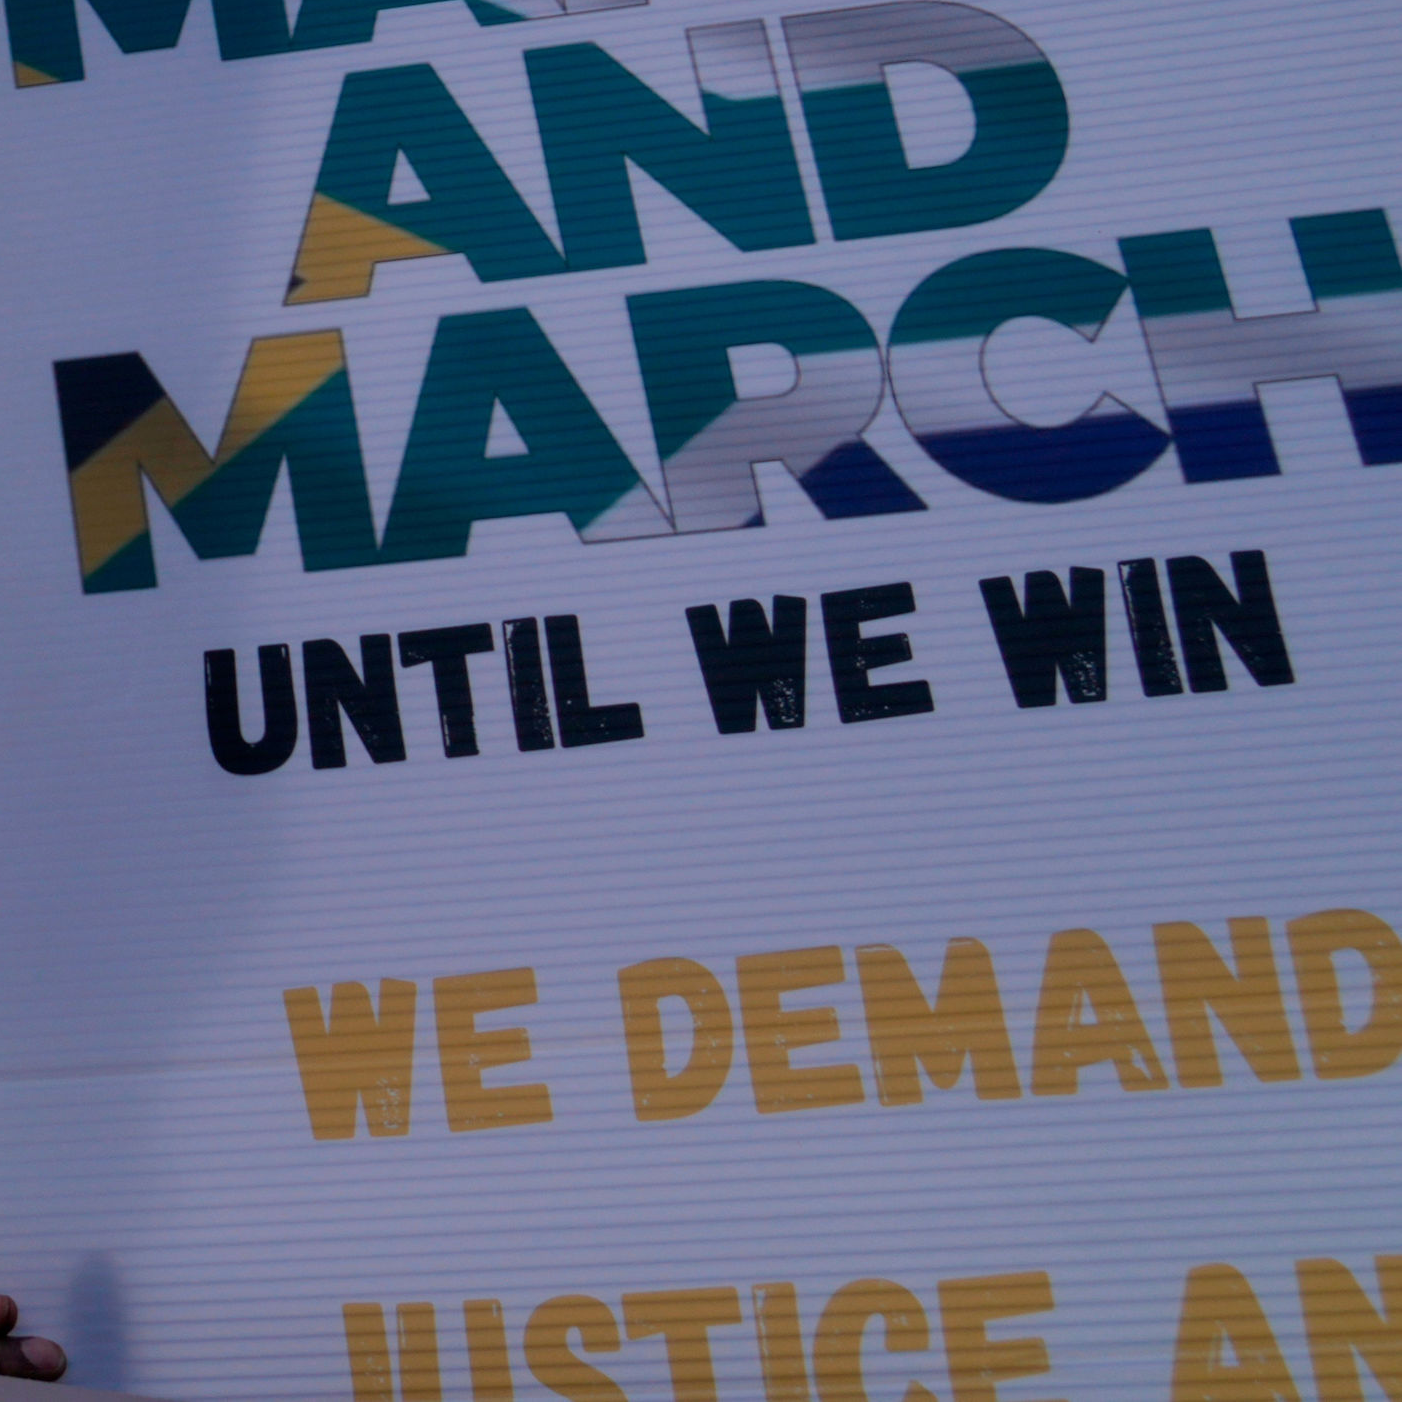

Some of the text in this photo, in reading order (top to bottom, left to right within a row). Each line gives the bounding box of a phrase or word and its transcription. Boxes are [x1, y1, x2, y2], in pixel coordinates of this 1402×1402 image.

[283, 0, 1070, 306] AND
[52, 207, 1402, 594] MARCH
[205, 547, 1296, 775] UNTIL WE WIN
[282, 907, 1402, 1141] WE DEMAND
